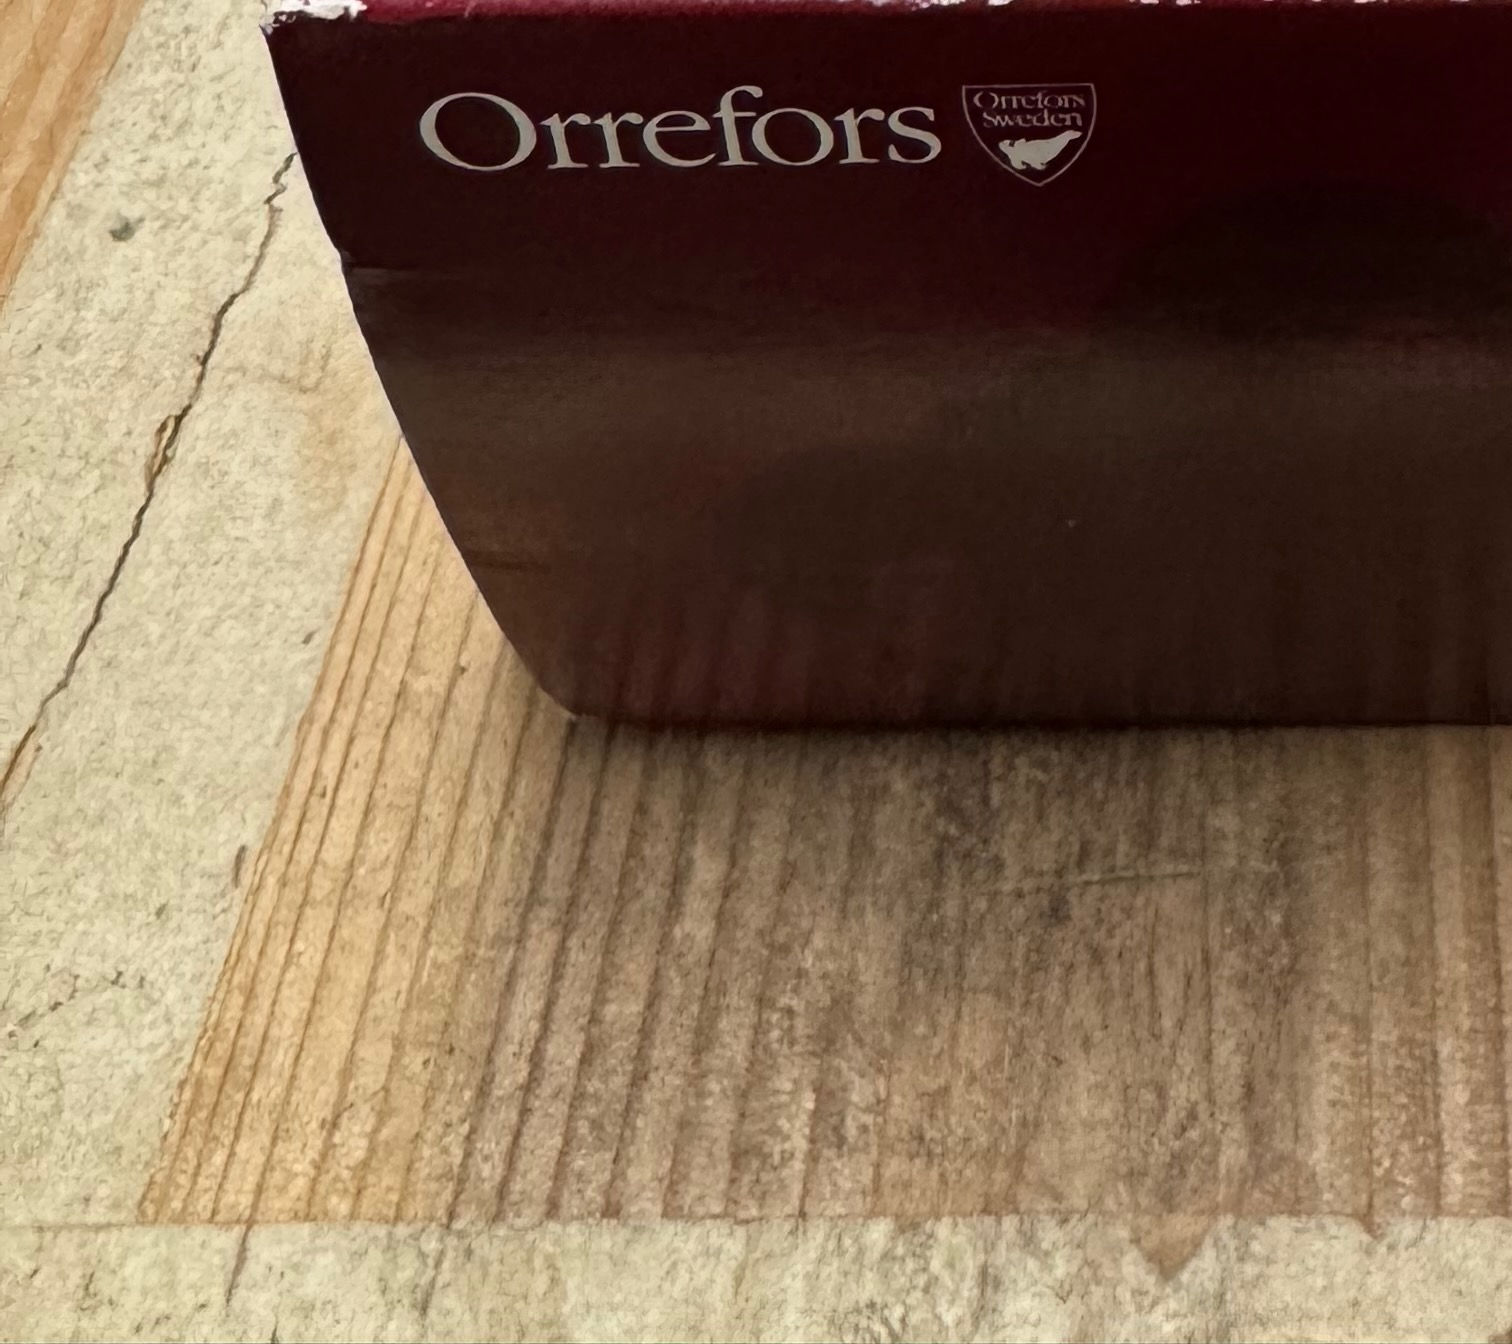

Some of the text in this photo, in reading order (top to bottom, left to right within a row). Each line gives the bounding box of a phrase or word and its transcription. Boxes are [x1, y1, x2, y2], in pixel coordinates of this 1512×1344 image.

[973, 91, 1085, 108] Orrefors
[982, 109, 1083, 127] Sweden
[419, 85, 942, 171] Orrefors
